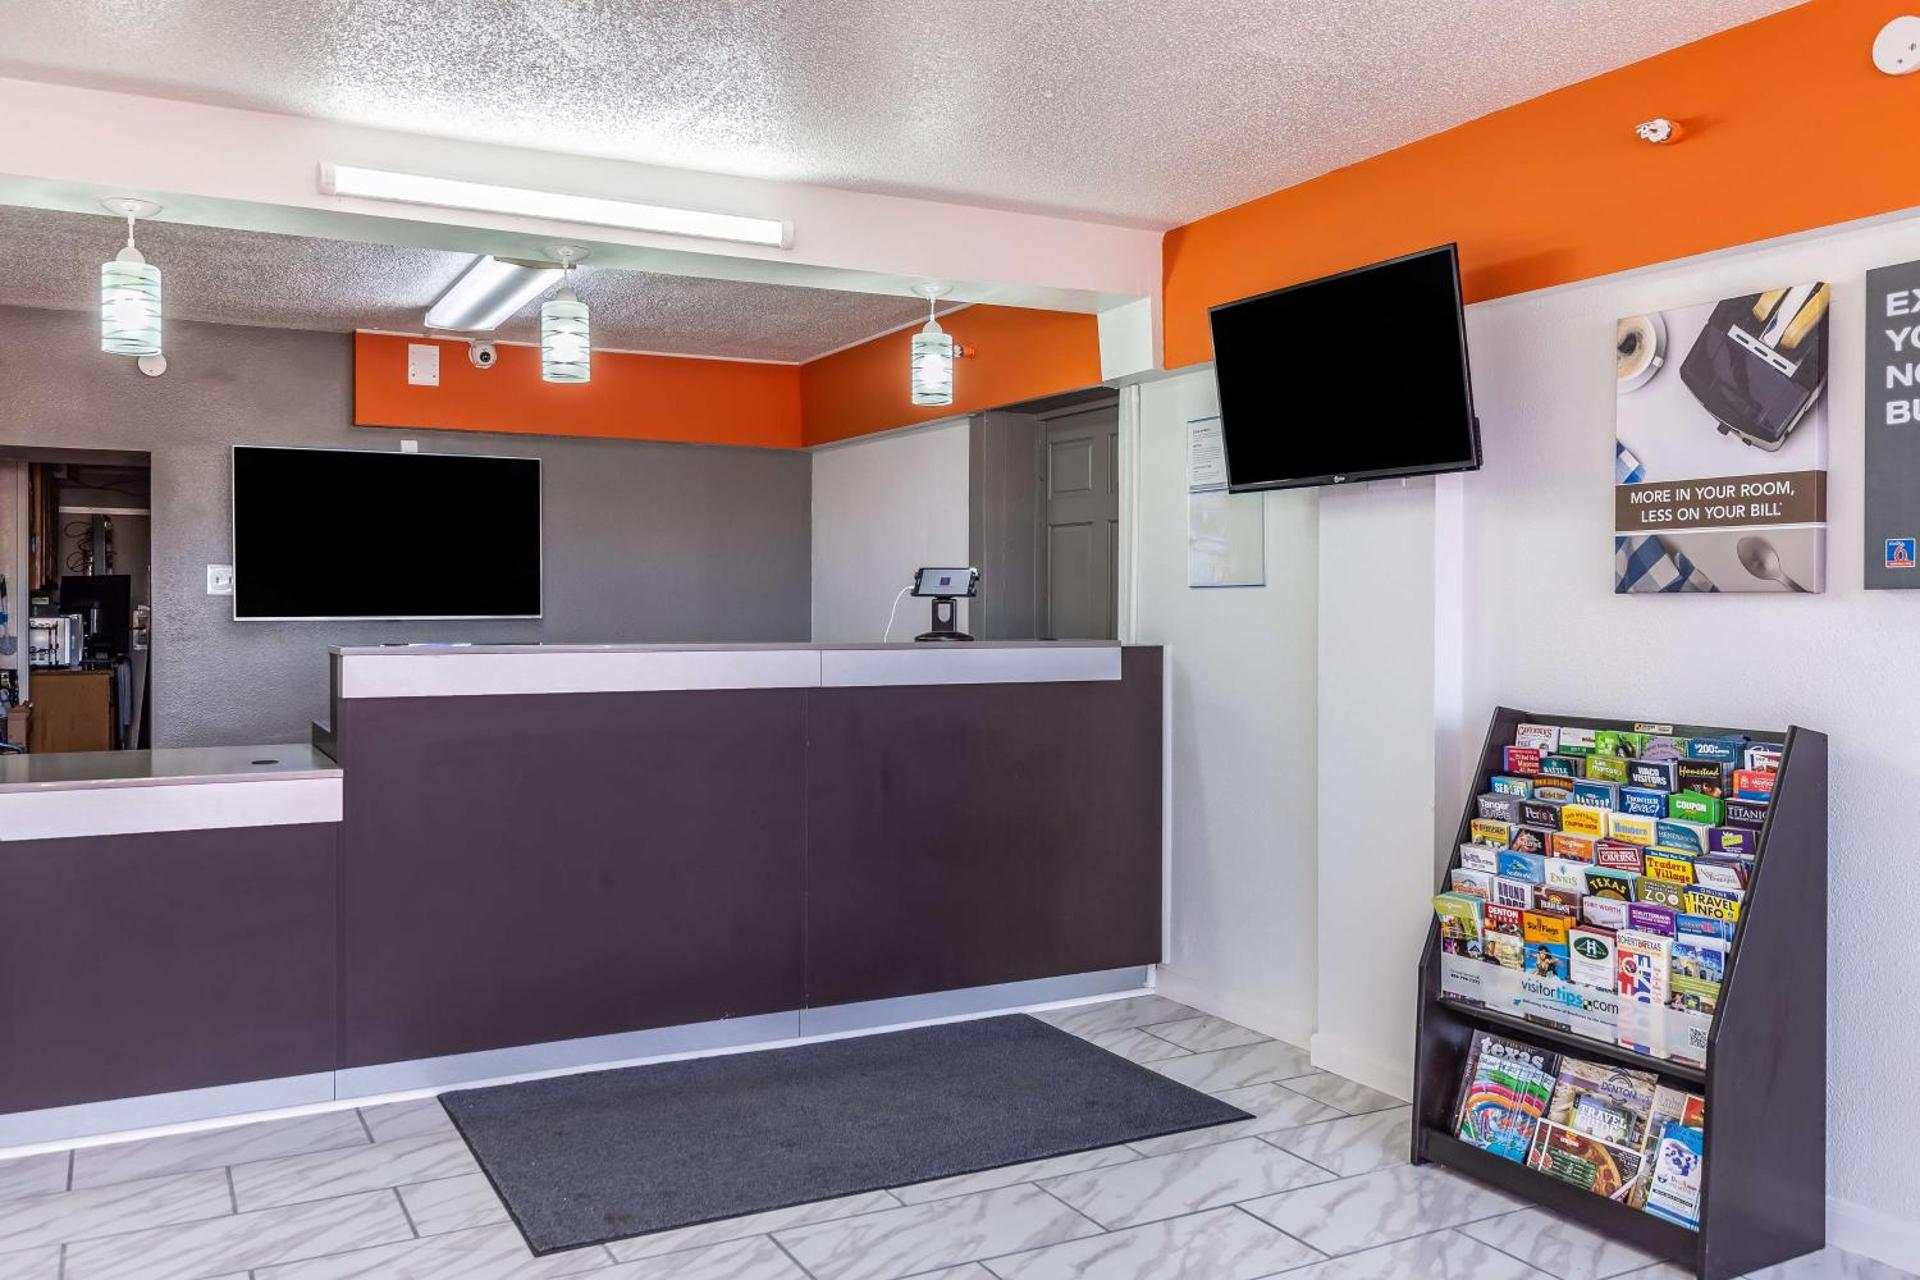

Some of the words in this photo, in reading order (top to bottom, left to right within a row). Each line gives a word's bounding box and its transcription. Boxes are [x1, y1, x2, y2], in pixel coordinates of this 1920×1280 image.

[1886, 362, 1920, 389] N
[1630, 489, 1671, 505] MORE
[1675, 488, 1691, 501] IN
[1695, 484, 1736, 500] YOUR
[1740, 480, 1795, 498] ROOM,
[1641, 507, 1672, 523] LESS
[1677, 506, 1700, 521] ON
[1704, 505, 1746, 520] YOUR
[1632, 772, 1667, 786] VISITORS
[1638, 766, 1660, 777] WACO
[1678, 765, 1720, 778] Homestead
[1479, 799, 1510, 811] Tanger
[1675, 800, 1707, 812] COUPON
[1646, 857, 1687, 873] Traders
[1654, 868, 1691, 883] Village
[1590, 877, 1627, 895] TEXAS
[1644, 889, 1679, 906] ZOO
[1693, 893, 1735, 912] TRAVEL
[1487, 904, 1519, 919] DENTON
[1599, 903, 1622, 914] WORTH
[1694, 905, 1724, 919] INFO
[1541, 924, 1559, 936] Flags
[1600, 1080, 1637, 1099] DENTON
[1579, 1104, 1627, 1130] TRAVEL
